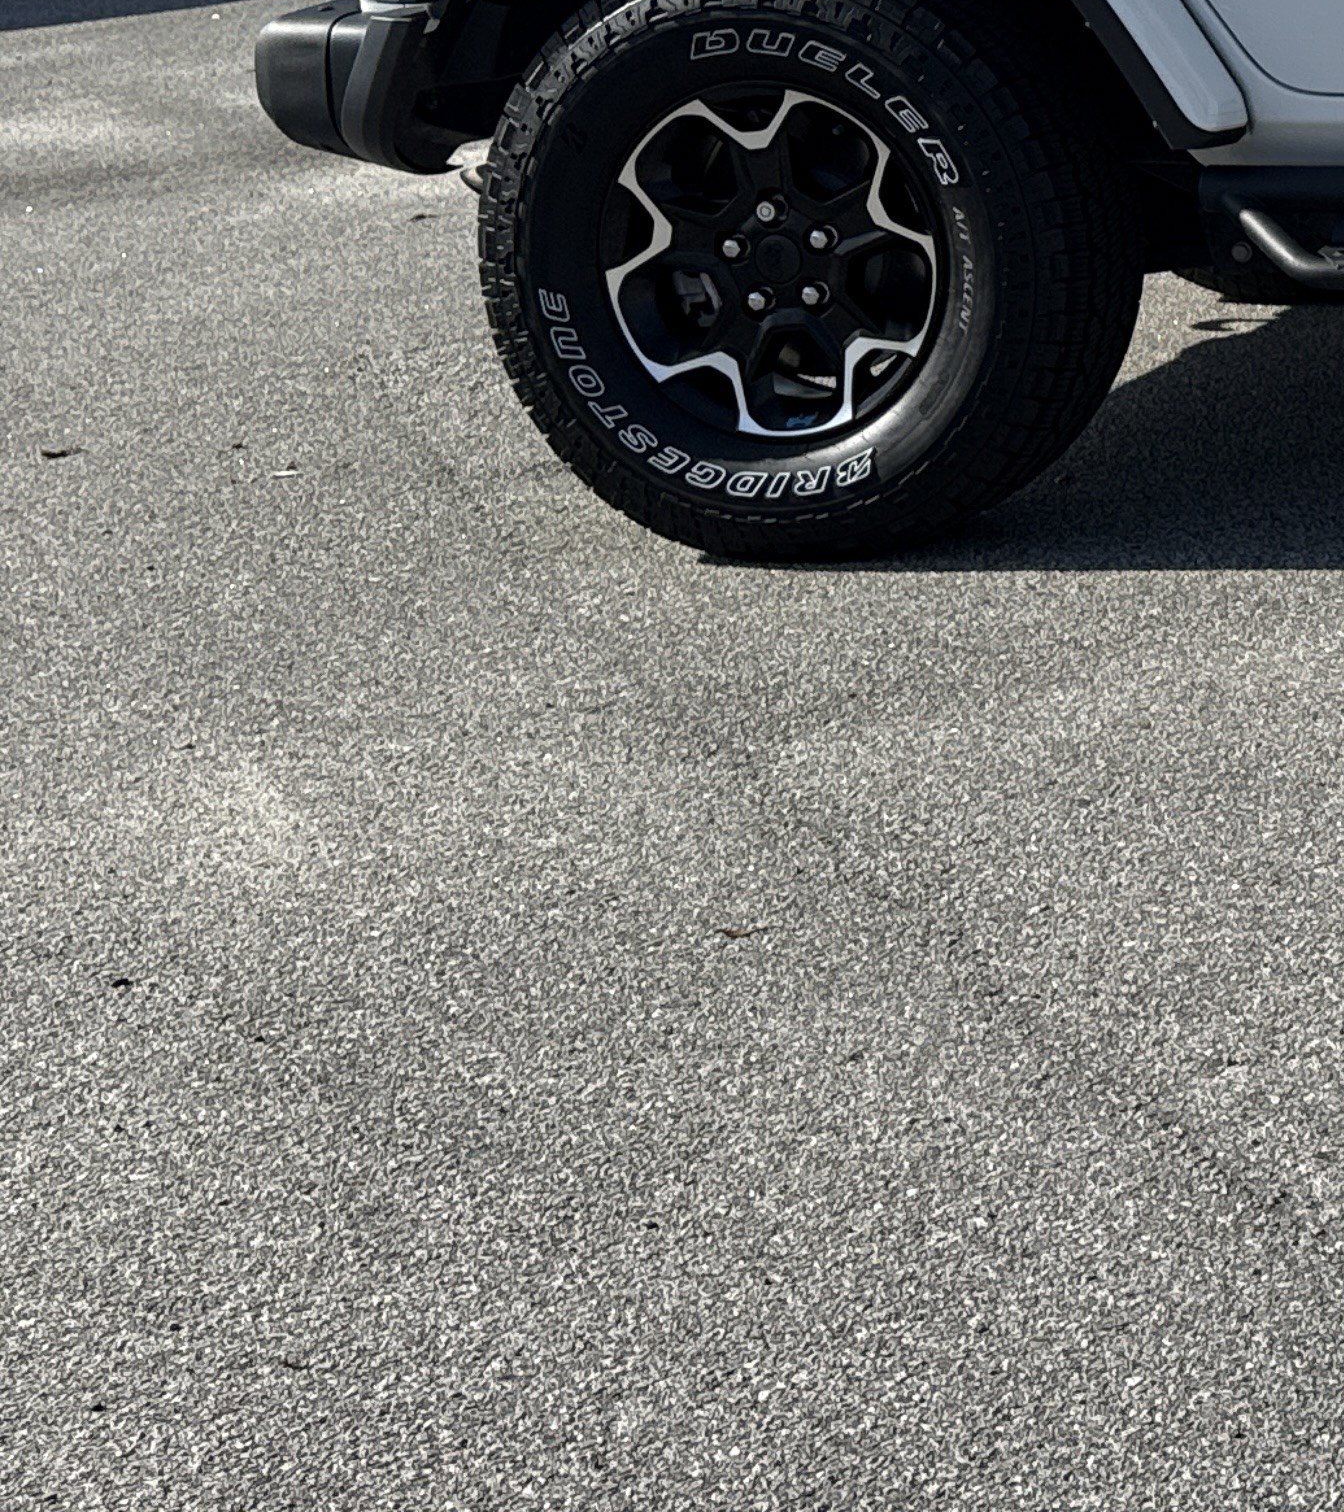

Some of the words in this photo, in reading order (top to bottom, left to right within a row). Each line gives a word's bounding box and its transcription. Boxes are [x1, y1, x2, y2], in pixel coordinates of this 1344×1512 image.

[691, 28, 959, 186] DUELER
[958, 255, 974, 335] ASCENT
[538, 288, 877, 498] BRIDGESTONE
